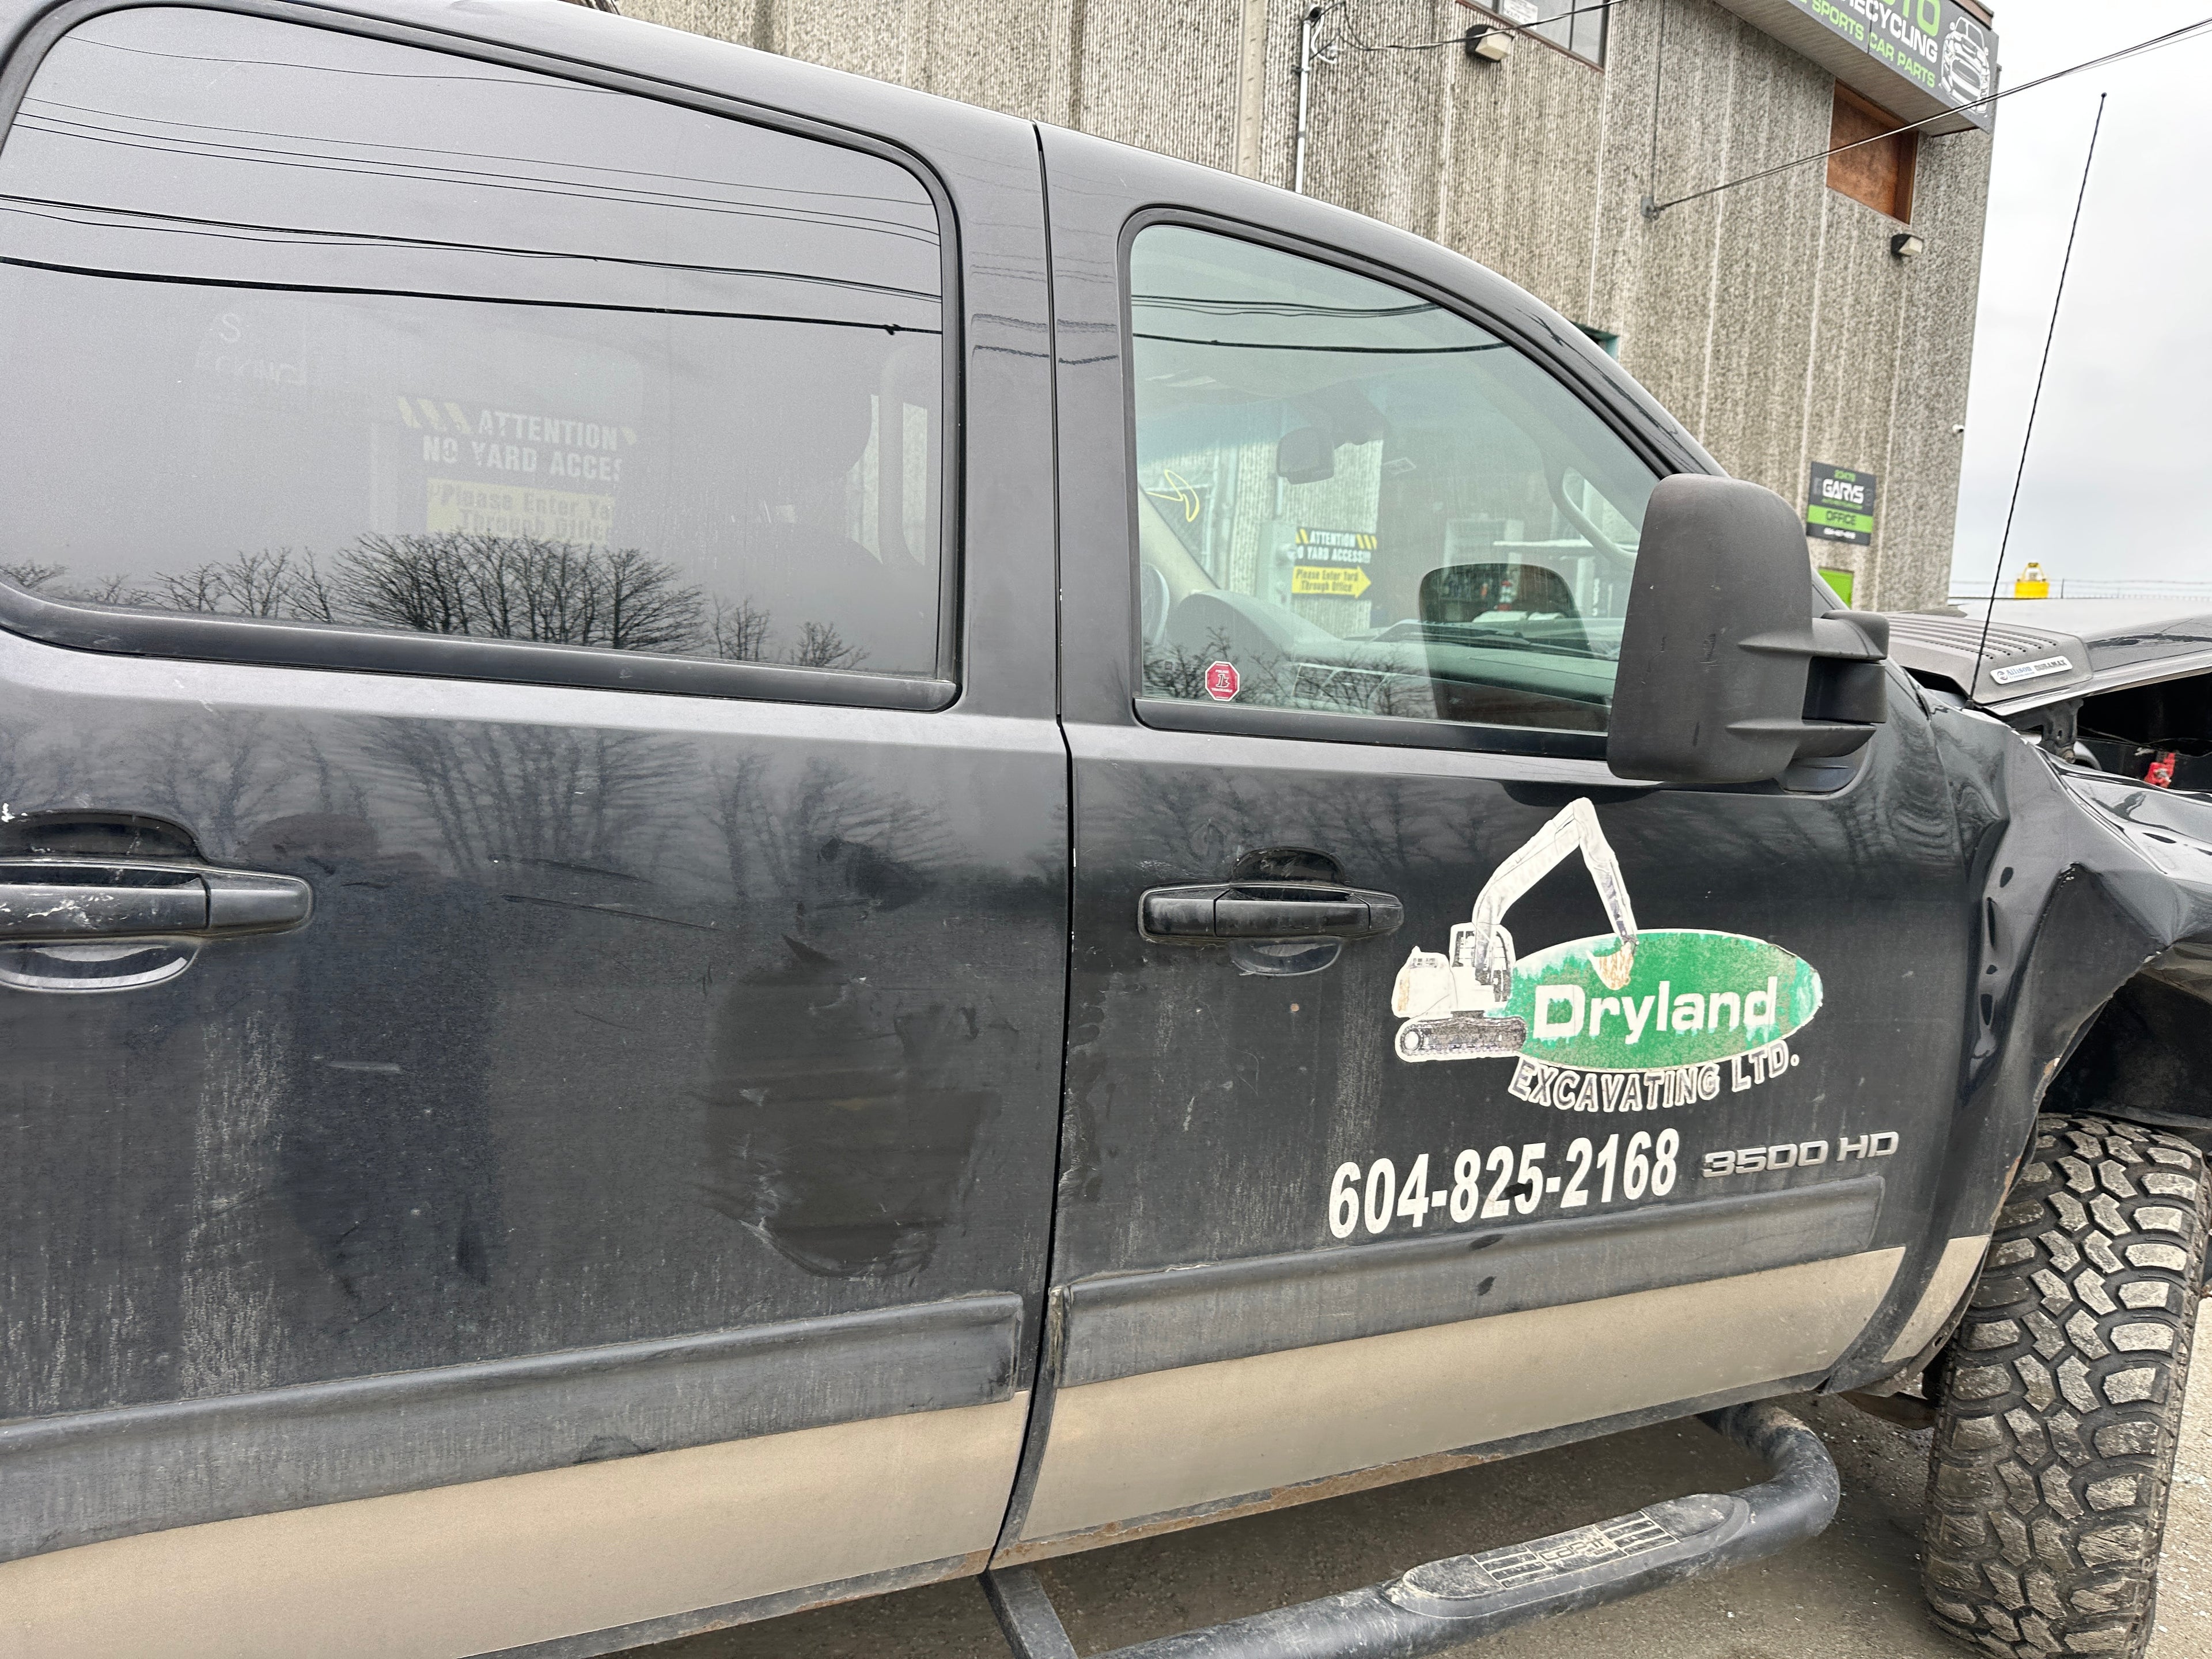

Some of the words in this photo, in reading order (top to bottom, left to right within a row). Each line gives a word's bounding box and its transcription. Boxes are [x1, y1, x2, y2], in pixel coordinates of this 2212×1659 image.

[1812, 0, 1864, 41] SPORTS
[1869, 32, 1894, 61] CAR
[1897, 51, 1936, 88] PARTS
[424, 435, 458, 463] NO
[471, 441, 537, 472] YARD
[479, 410, 618, 452] ATTENTION
[1309, 531, 1357, 547] ATTENTION
[1532, 976, 1778, 1046] Dryland
[1508, 1056, 1720, 1112] EXCAVATING
[1730, 1039, 1800, 1092] LTD.
[1328, 1128, 1680, 1238] 604-825-2168
[1702, 1140, 1829, 1178] 3500
[1836, 1131, 1899, 1162] HD
